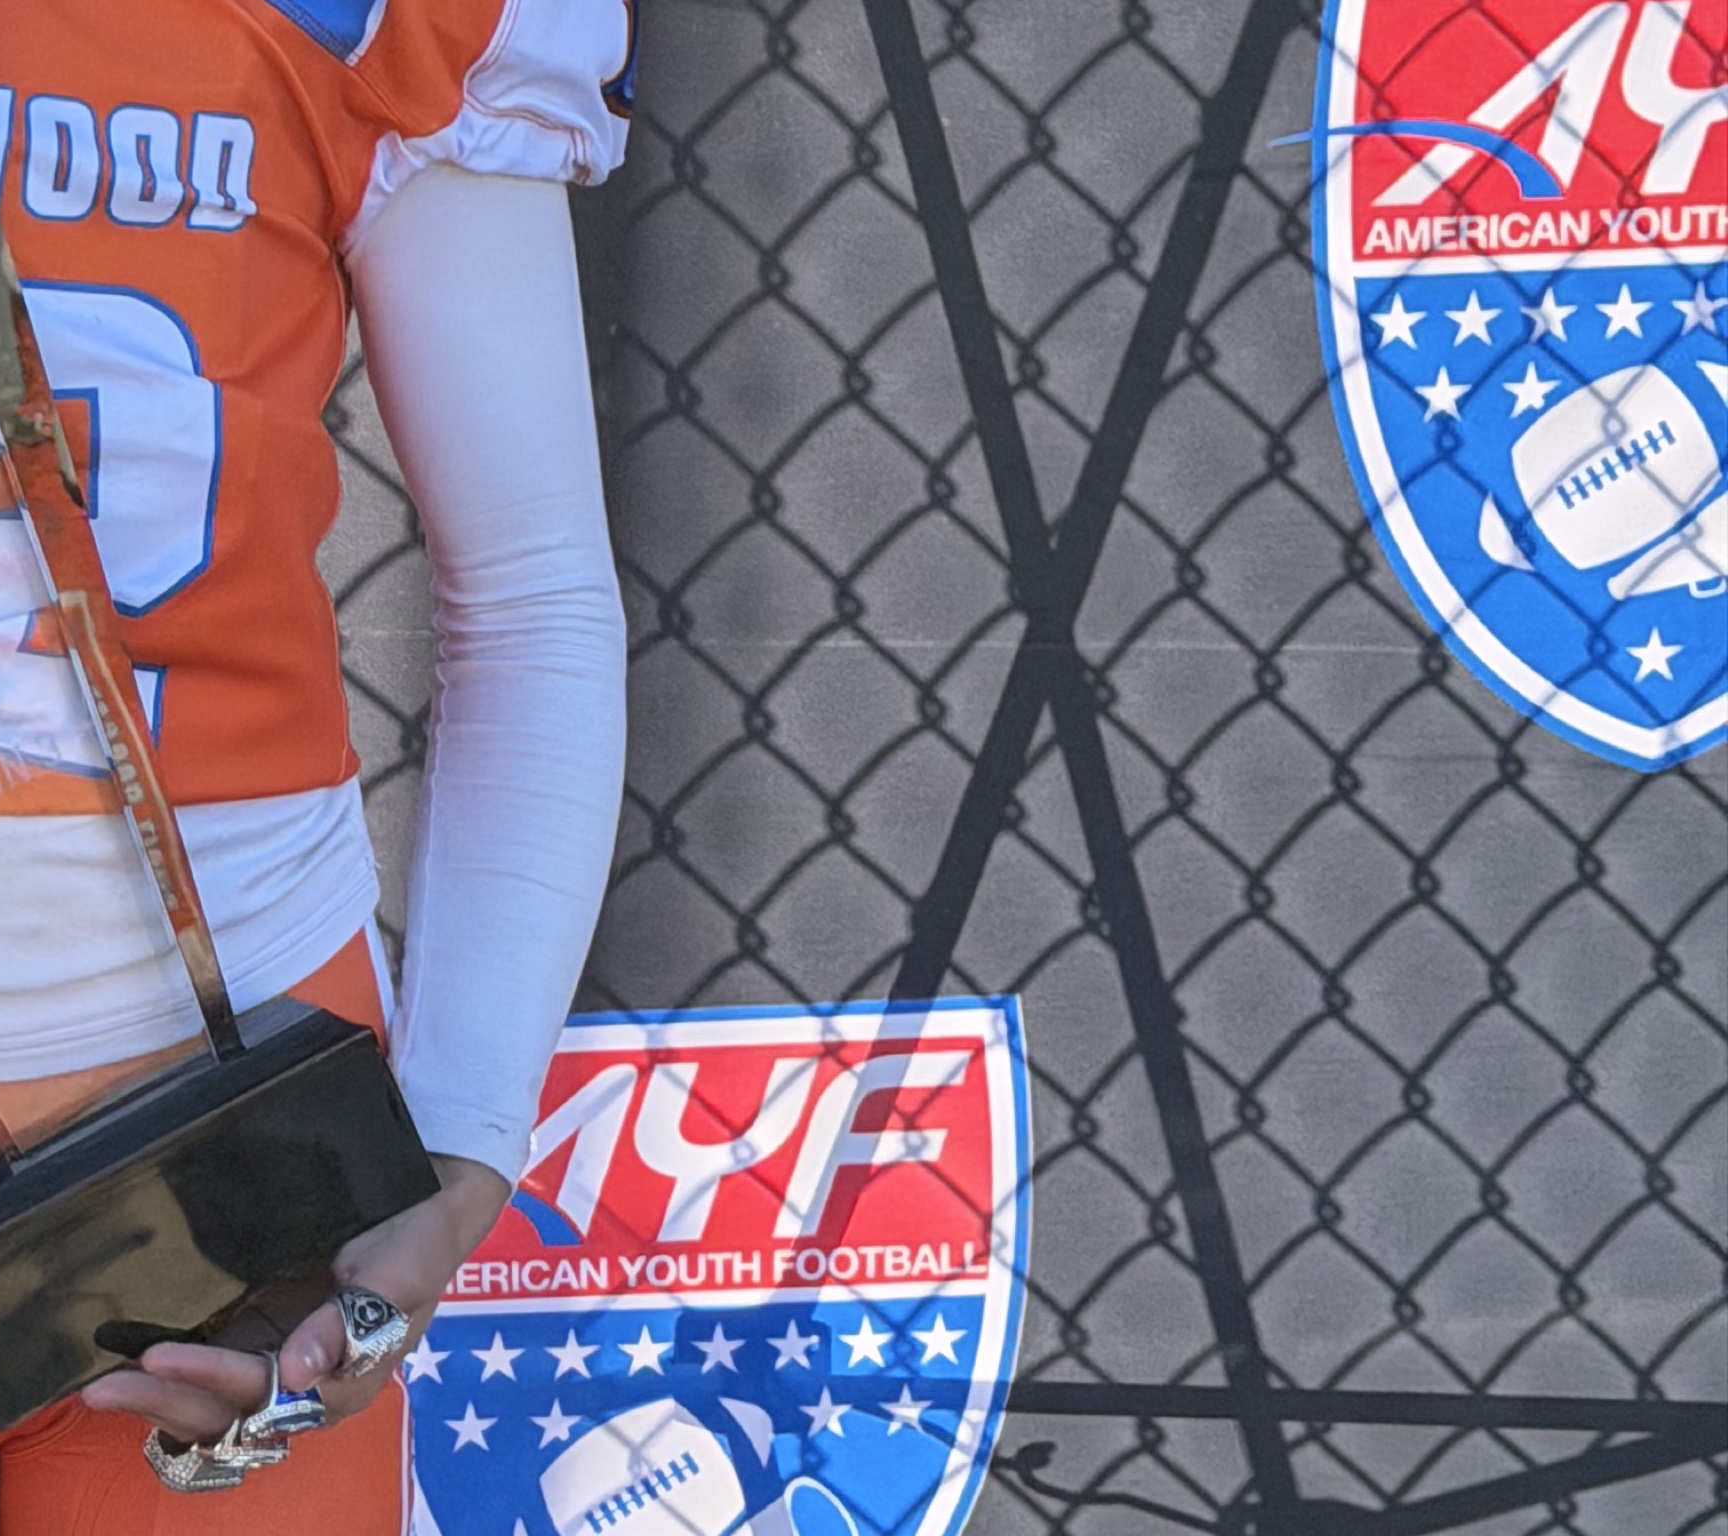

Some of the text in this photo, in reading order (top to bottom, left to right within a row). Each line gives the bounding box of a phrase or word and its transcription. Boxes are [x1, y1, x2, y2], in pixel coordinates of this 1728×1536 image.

[1372, 0, 1728, 207] AY
[1364, 214, 1589, 254] AMERICAN
[522, 1051, 976, 1243] AYF
[445, 1241, 988, 1296] ERICAN YOUTH FOOTBALL
